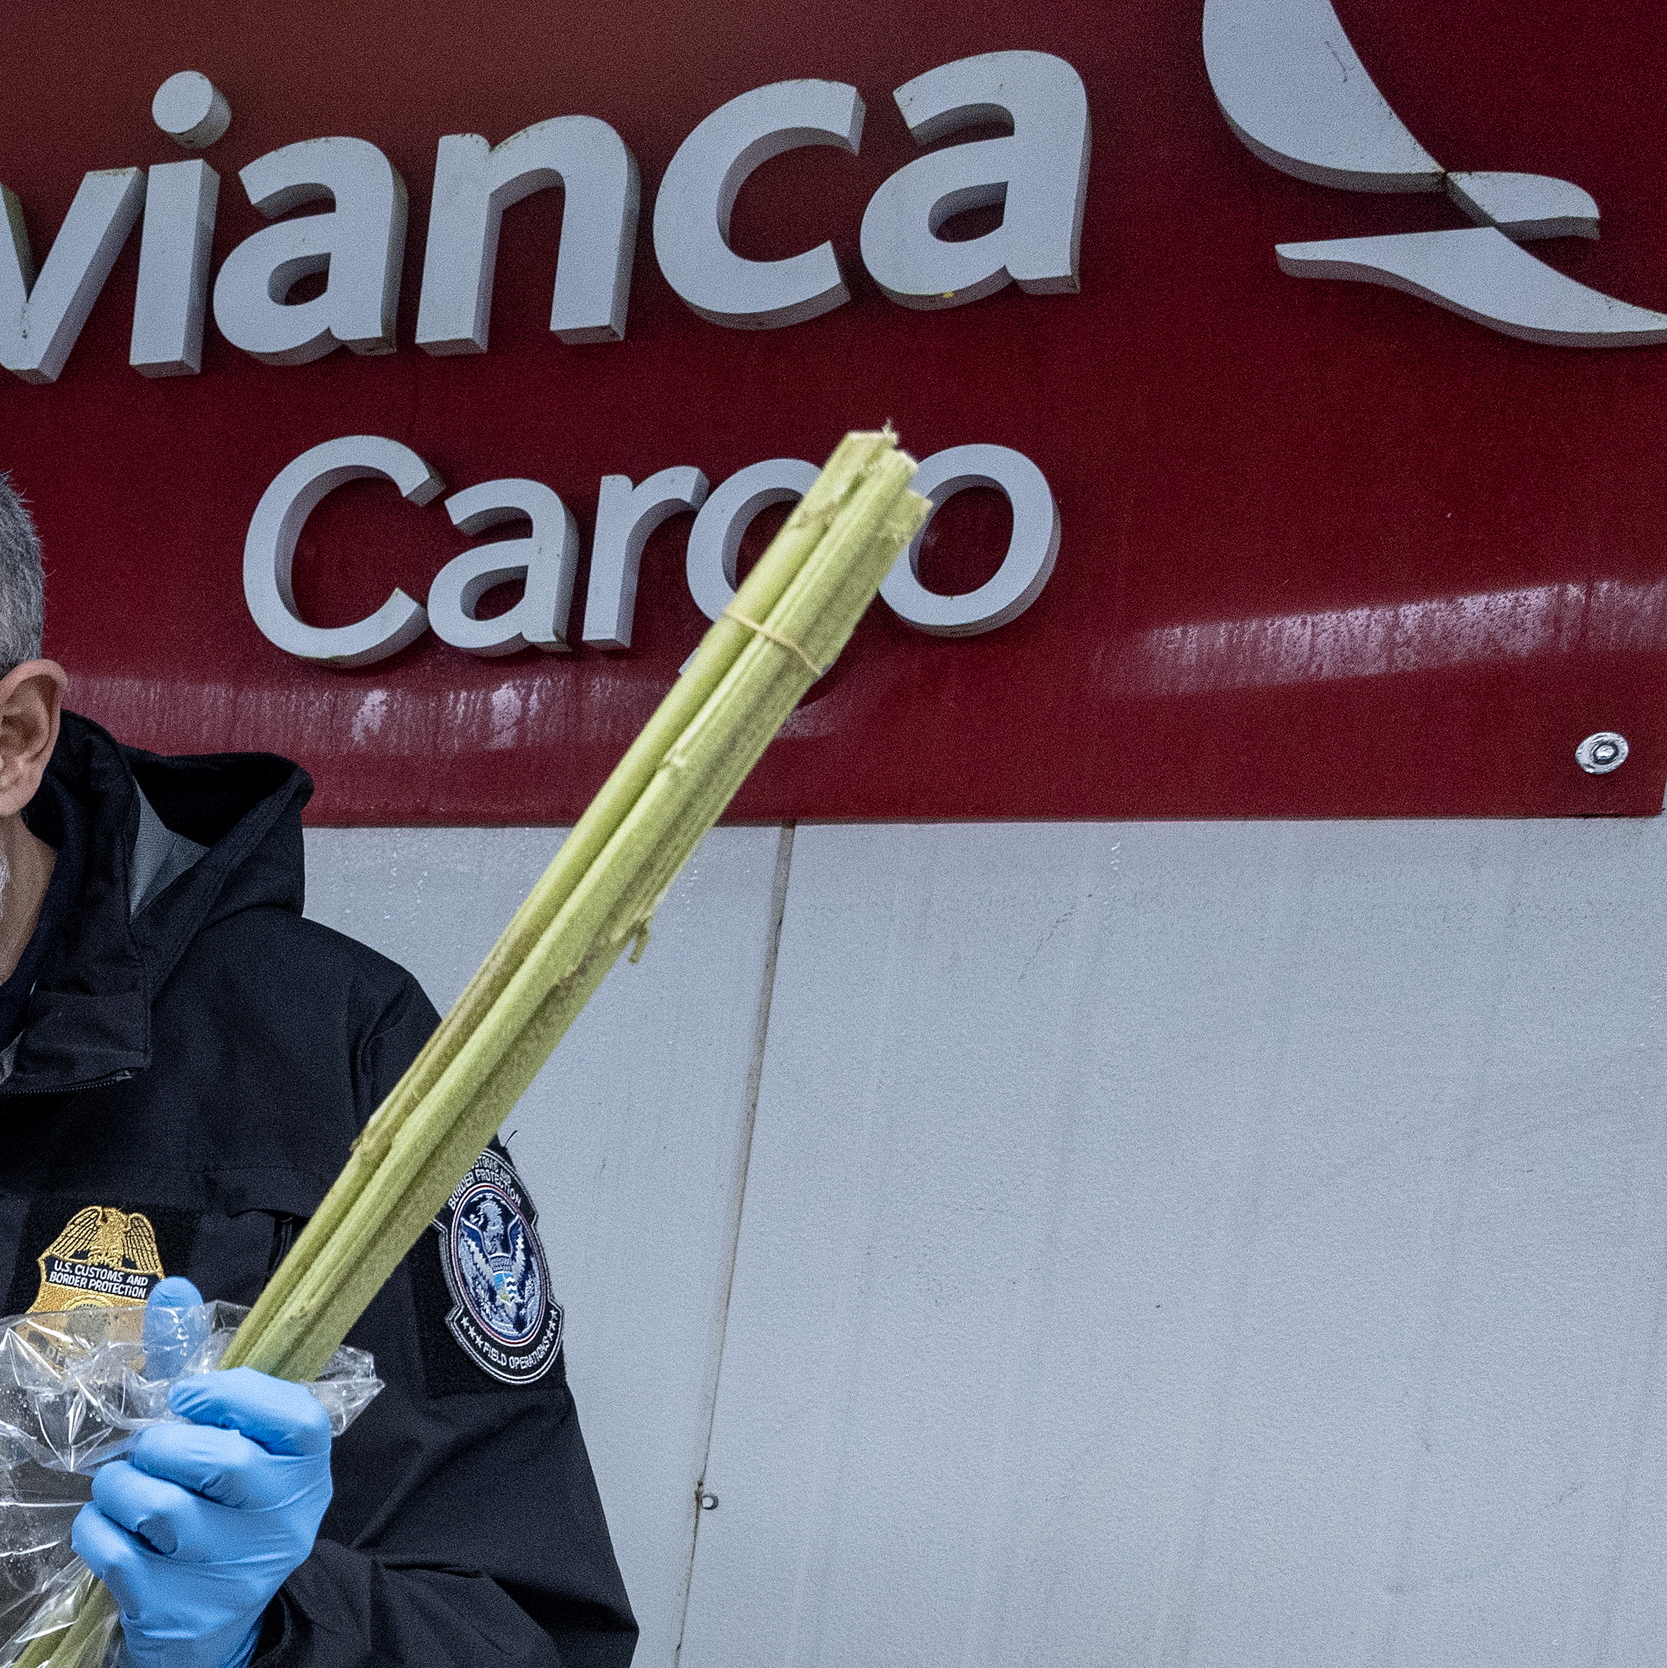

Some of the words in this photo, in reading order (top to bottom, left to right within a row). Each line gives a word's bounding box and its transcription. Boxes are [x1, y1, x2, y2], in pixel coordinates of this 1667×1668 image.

[49, 1271, 88, 1288] BORDER
[88, 1279, 147, 1299] PROTECTION
[54, 1260, 73, 1274] U.S.
[74, 1264, 125, 1283] CUSTOMS
[126, 1274, 149, 1286] AND
[483, 1342, 507, 1366] FIELD
[508, 1335, 550, 1370] OPERATIONS
